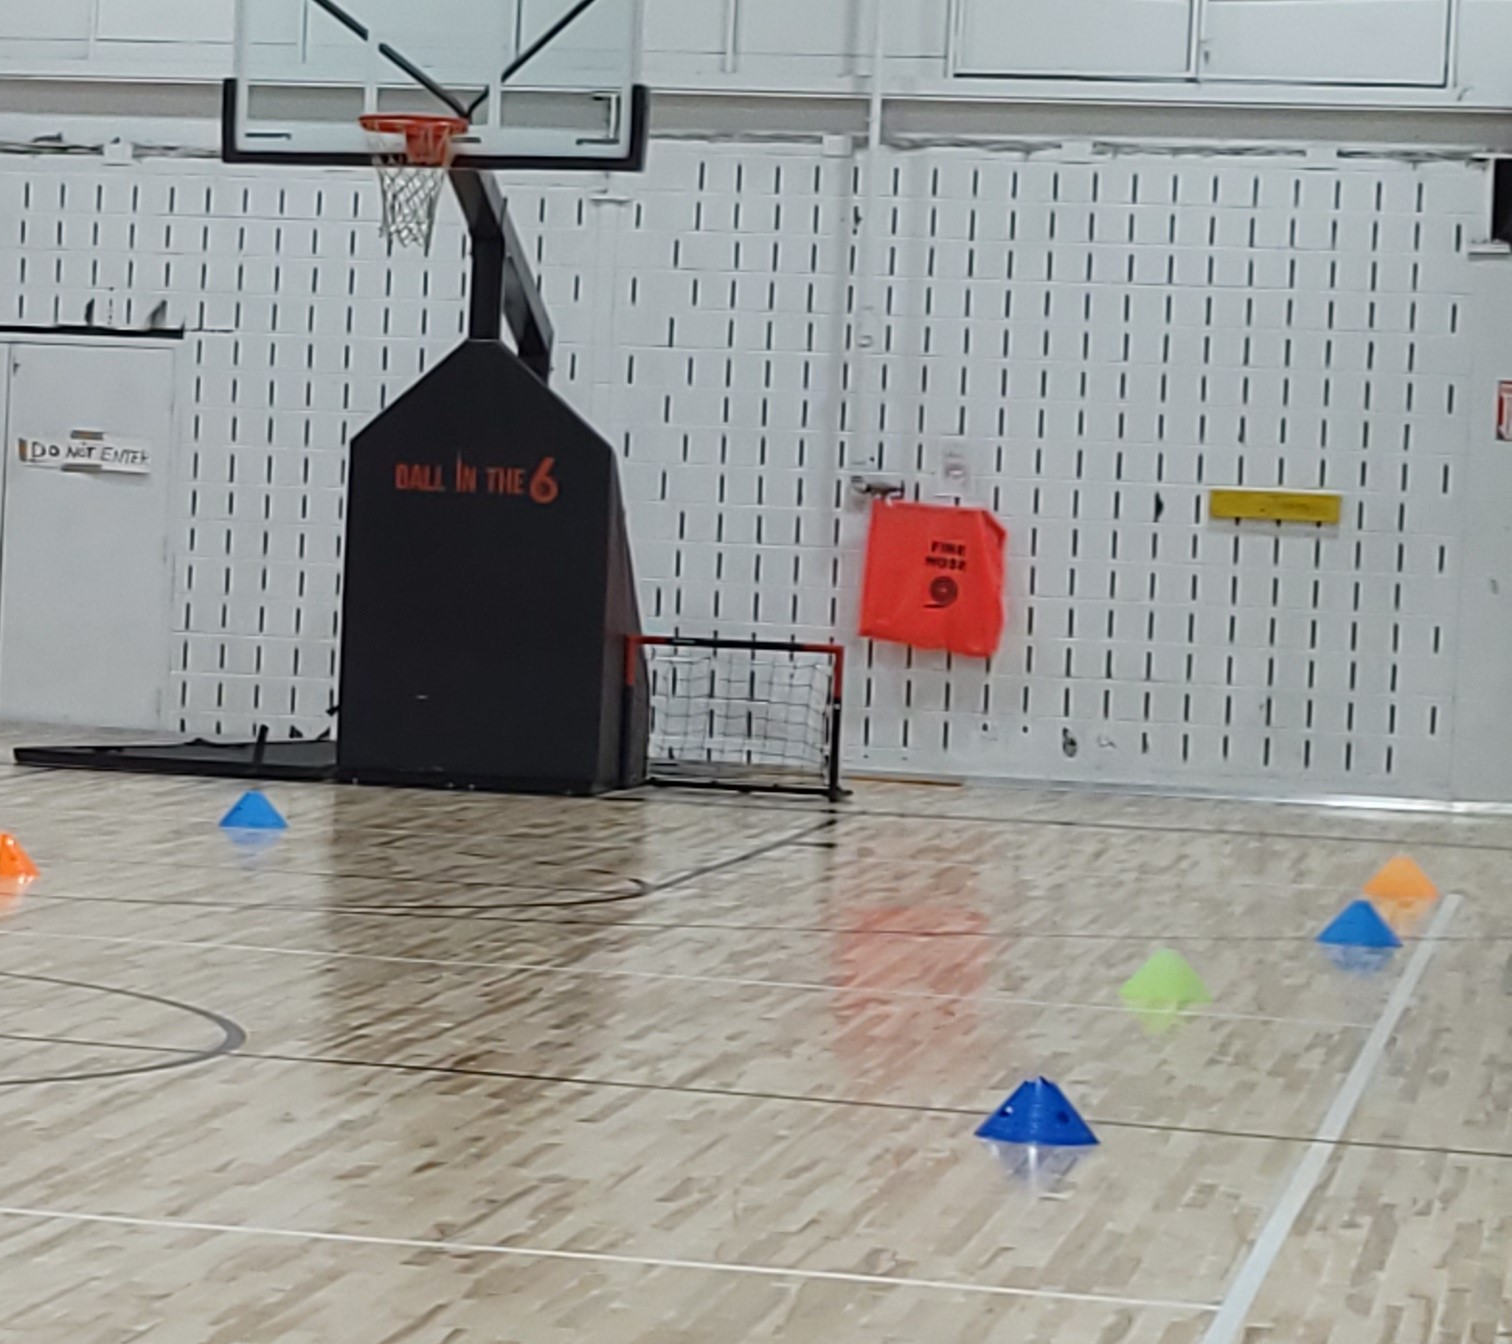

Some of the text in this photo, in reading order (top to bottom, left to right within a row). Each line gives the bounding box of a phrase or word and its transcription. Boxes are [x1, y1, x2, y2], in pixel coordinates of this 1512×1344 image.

[31, 441, 149, 464] DO NOT ENTER
[395, 453, 558, 504] BALL IN THE 6
[930, 541, 966, 556] FIRE
[925, 555, 966, 571] HOSE
